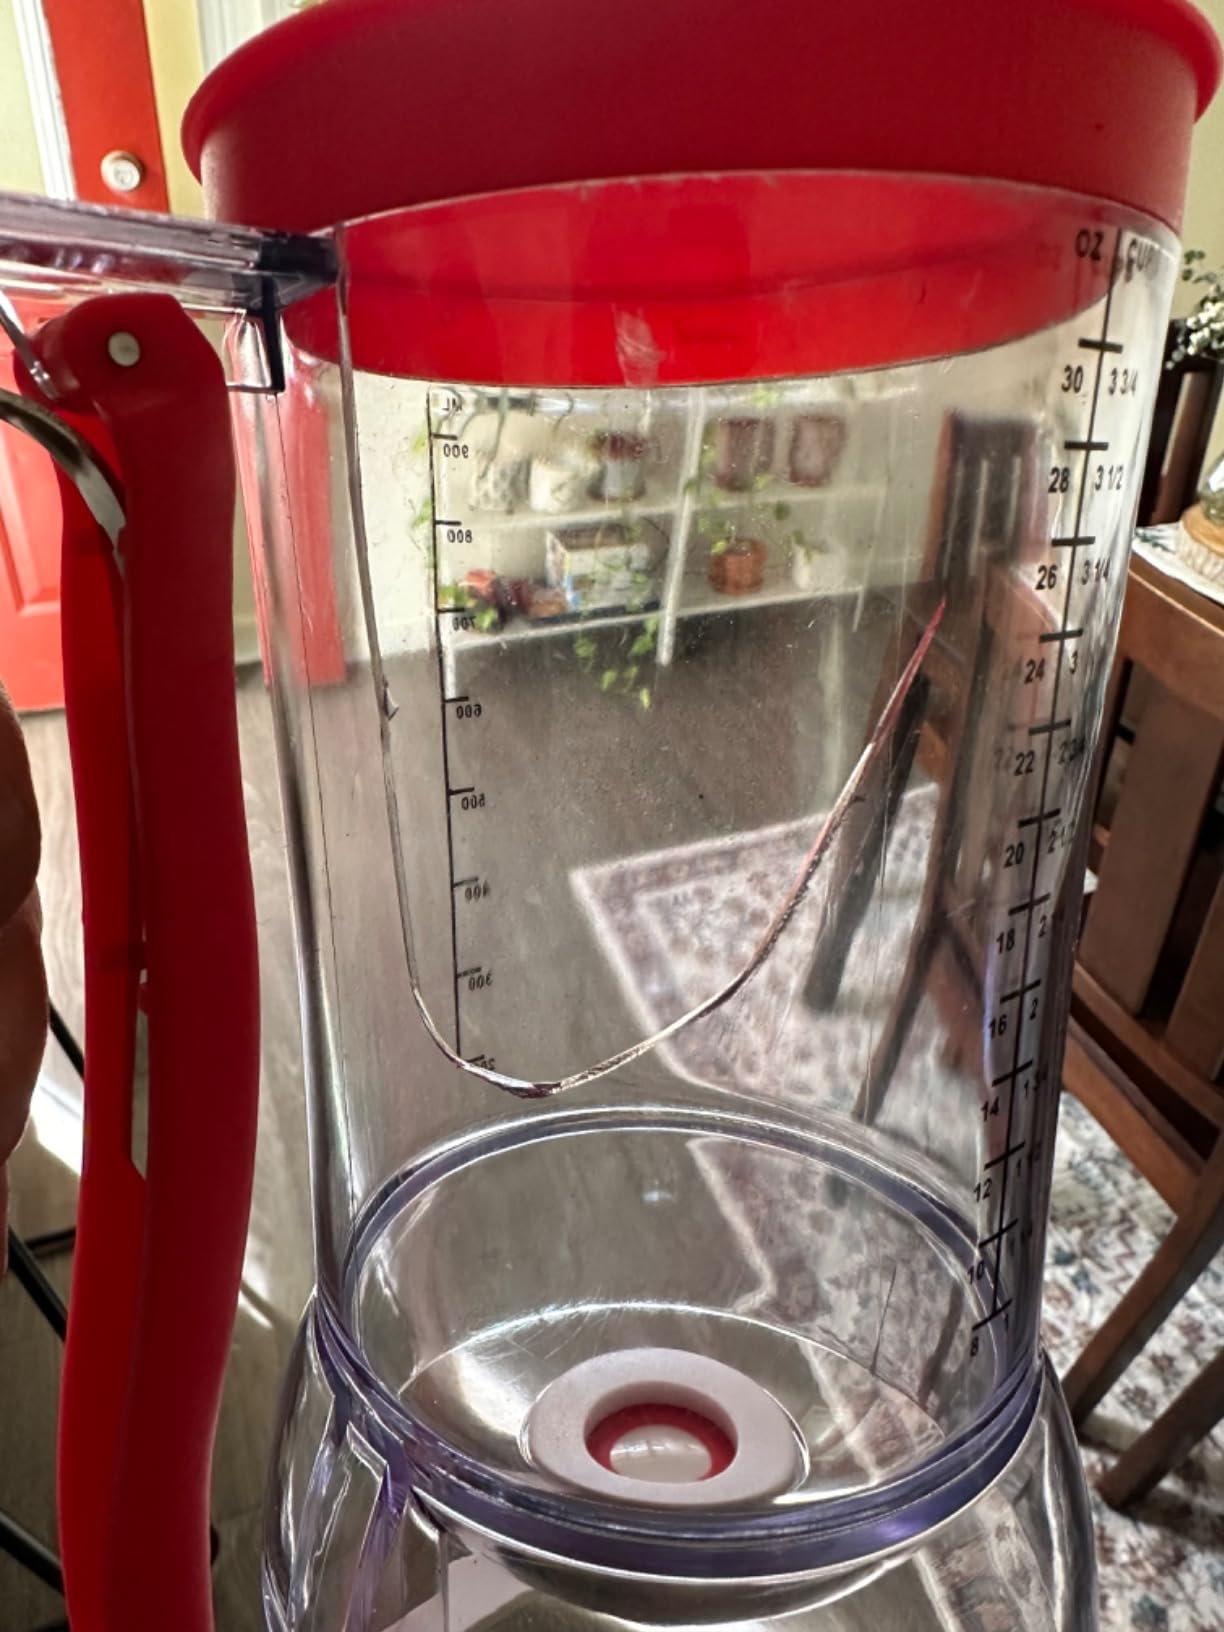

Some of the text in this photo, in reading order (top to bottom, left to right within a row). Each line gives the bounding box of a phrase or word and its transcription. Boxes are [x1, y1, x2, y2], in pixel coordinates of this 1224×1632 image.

[1075, 229, 1104, 261] OZ
[1061, 364, 1083, 393] 30
[1108, 368, 1117, 396] 3
[1048, 466, 1070, 493] 28
[1095, 465, 1104, 491] 3
[1035, 565, 1057, 590] 26
[1081, 560, 1091, 585] 3
[1024, 658, 1045, 684] 24
[1069, 651, 1078, 675] 3
[1013, 751, 1035, 777] 22
[1004, 842, 1025, 868] 20
[996, 929, 1015, 954] 18
[989, 1014, 1007, 1038] 16
[981, 1096, 999, 1122] 14
[973, 1178, 992, 1202] 12
[967, 1260, 985, 1284] 10
[970, 1336, 979, 1358] 8
